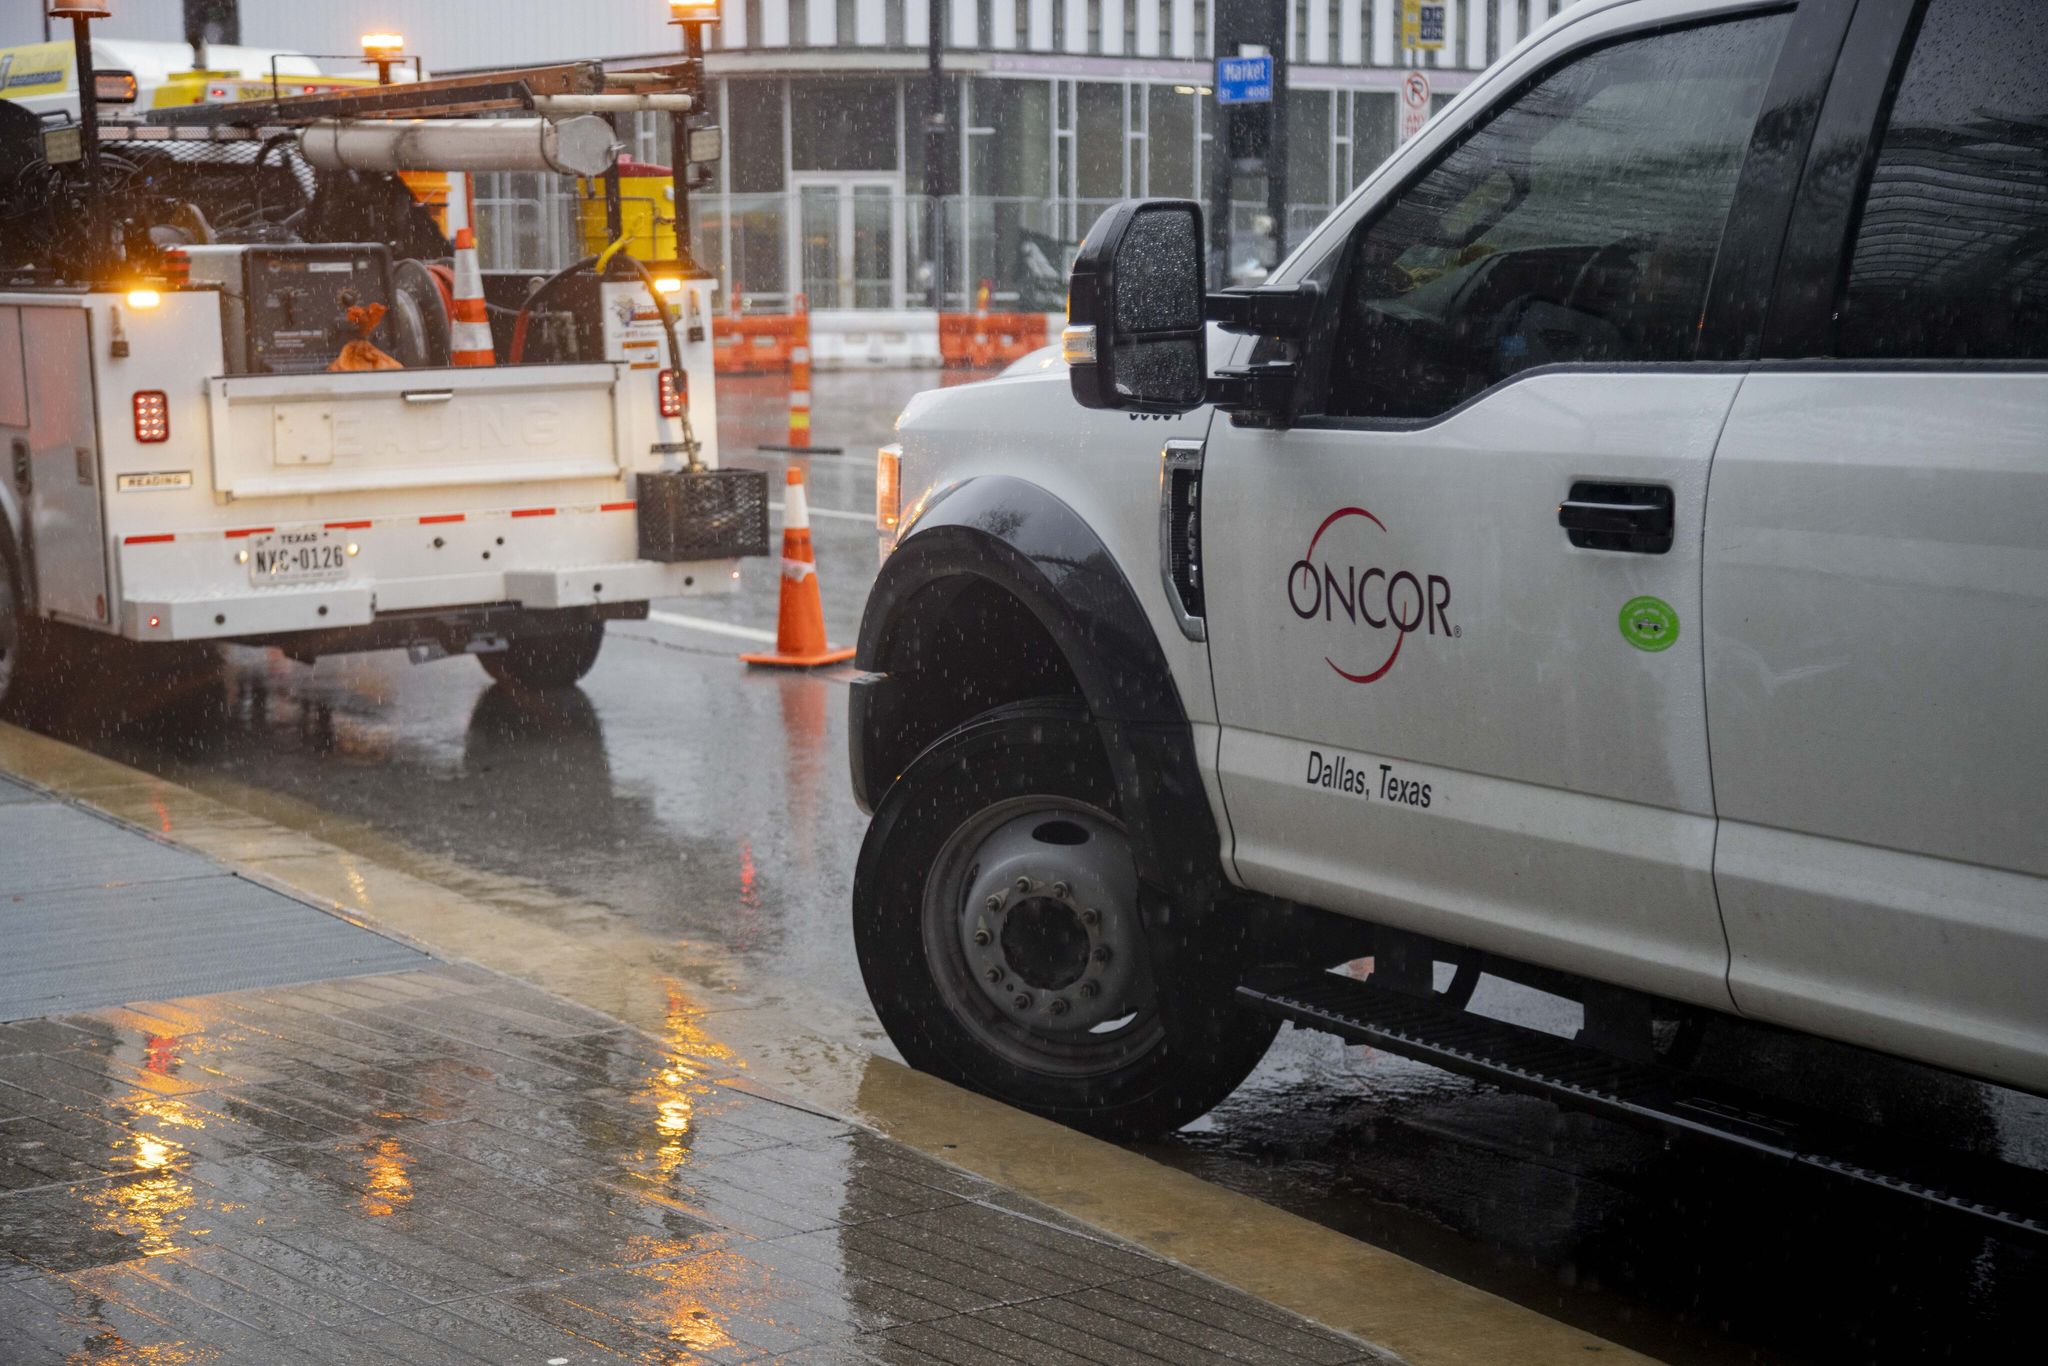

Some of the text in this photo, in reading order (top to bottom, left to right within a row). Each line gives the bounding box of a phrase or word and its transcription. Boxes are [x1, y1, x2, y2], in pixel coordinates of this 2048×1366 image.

[1225, 61, 1265, 81] Market
[1406, 114, 1425, 123] ANY
[128, 475, 182, 487] READING
[281, 534, 318, 543] TEXAS
[1306, 751, 1432, 808] Dallas, Texas
